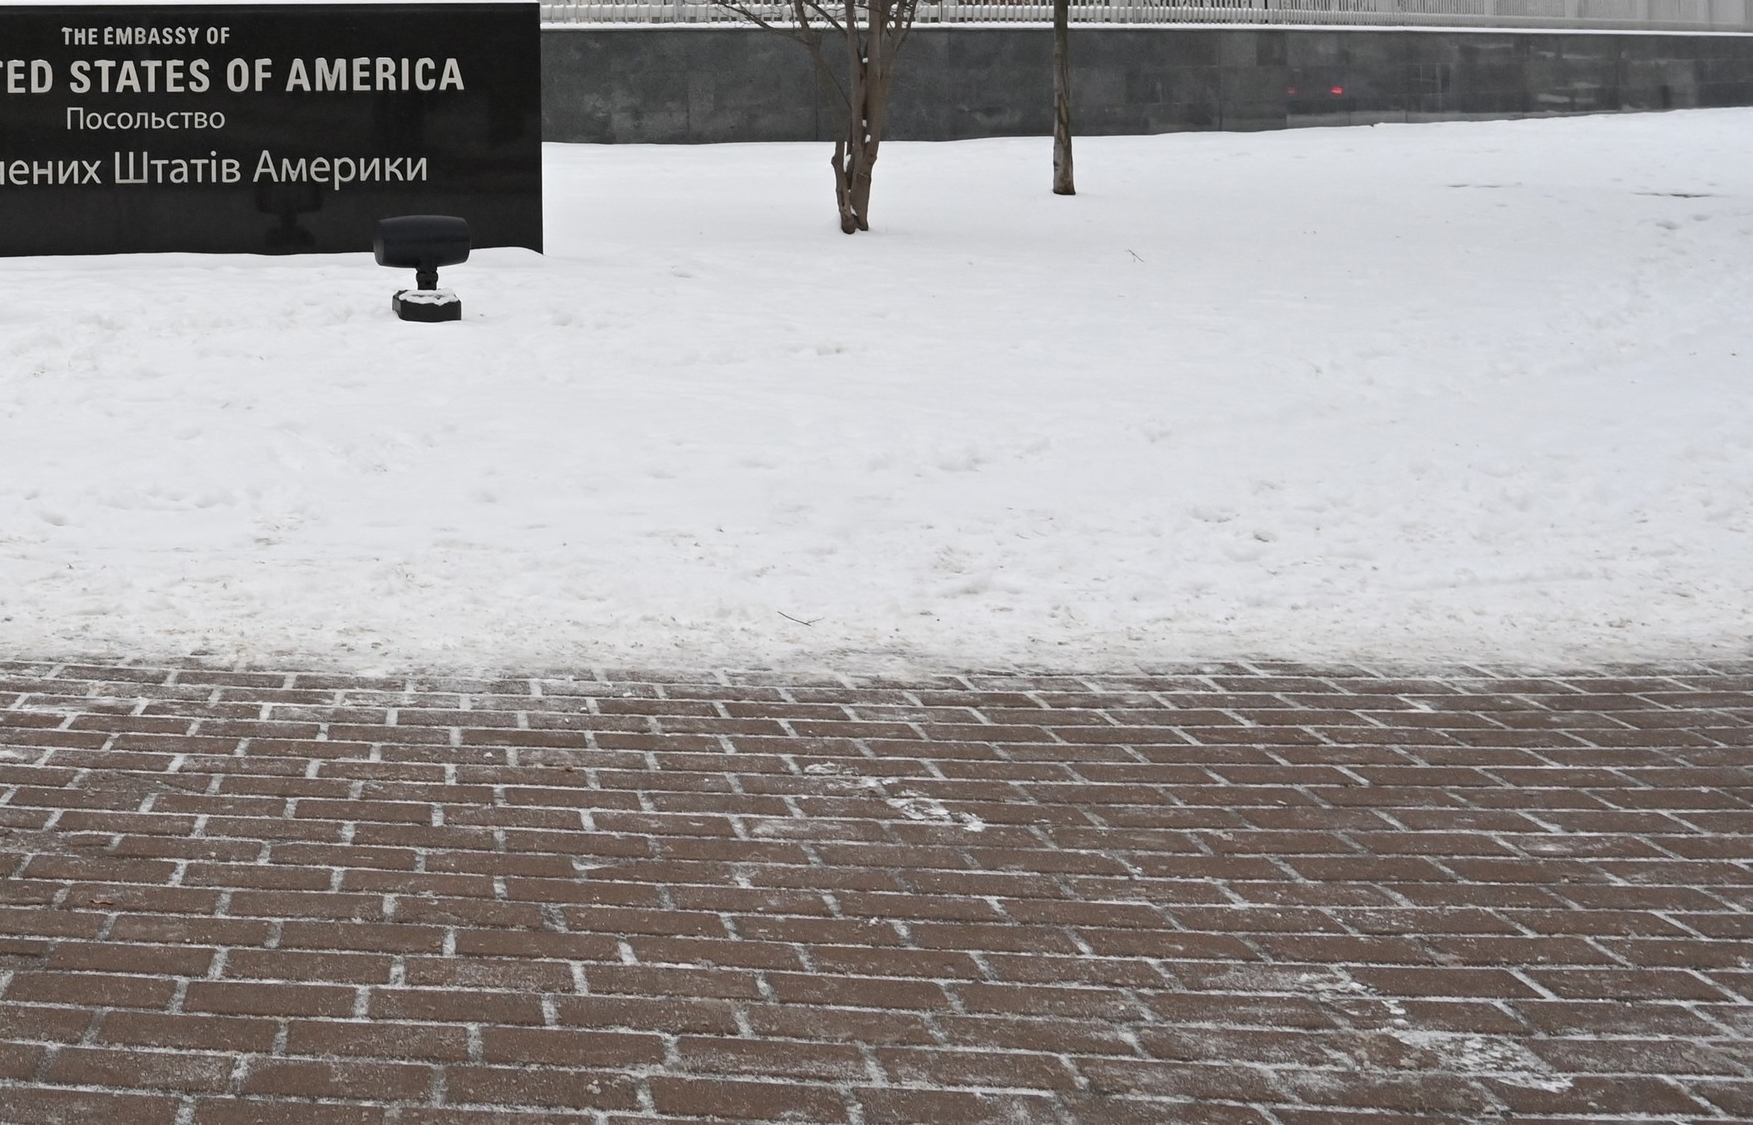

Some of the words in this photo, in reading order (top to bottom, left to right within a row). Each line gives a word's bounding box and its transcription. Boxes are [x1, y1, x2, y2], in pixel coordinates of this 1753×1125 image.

[61, 26, 98, 46] THE
[103, 26, 200, 46] EMBASSY
[206, 26, 230, 45] OF
[69, 58, 210, 94] STATES
[226, 57, 272, 93] OF
[285, 56, 465, 92] AMERICA
[66, 106, 226, 130] Посольство
[114, 150, 241, 184] Штатів
[252, 149, 427, 191] Америки
